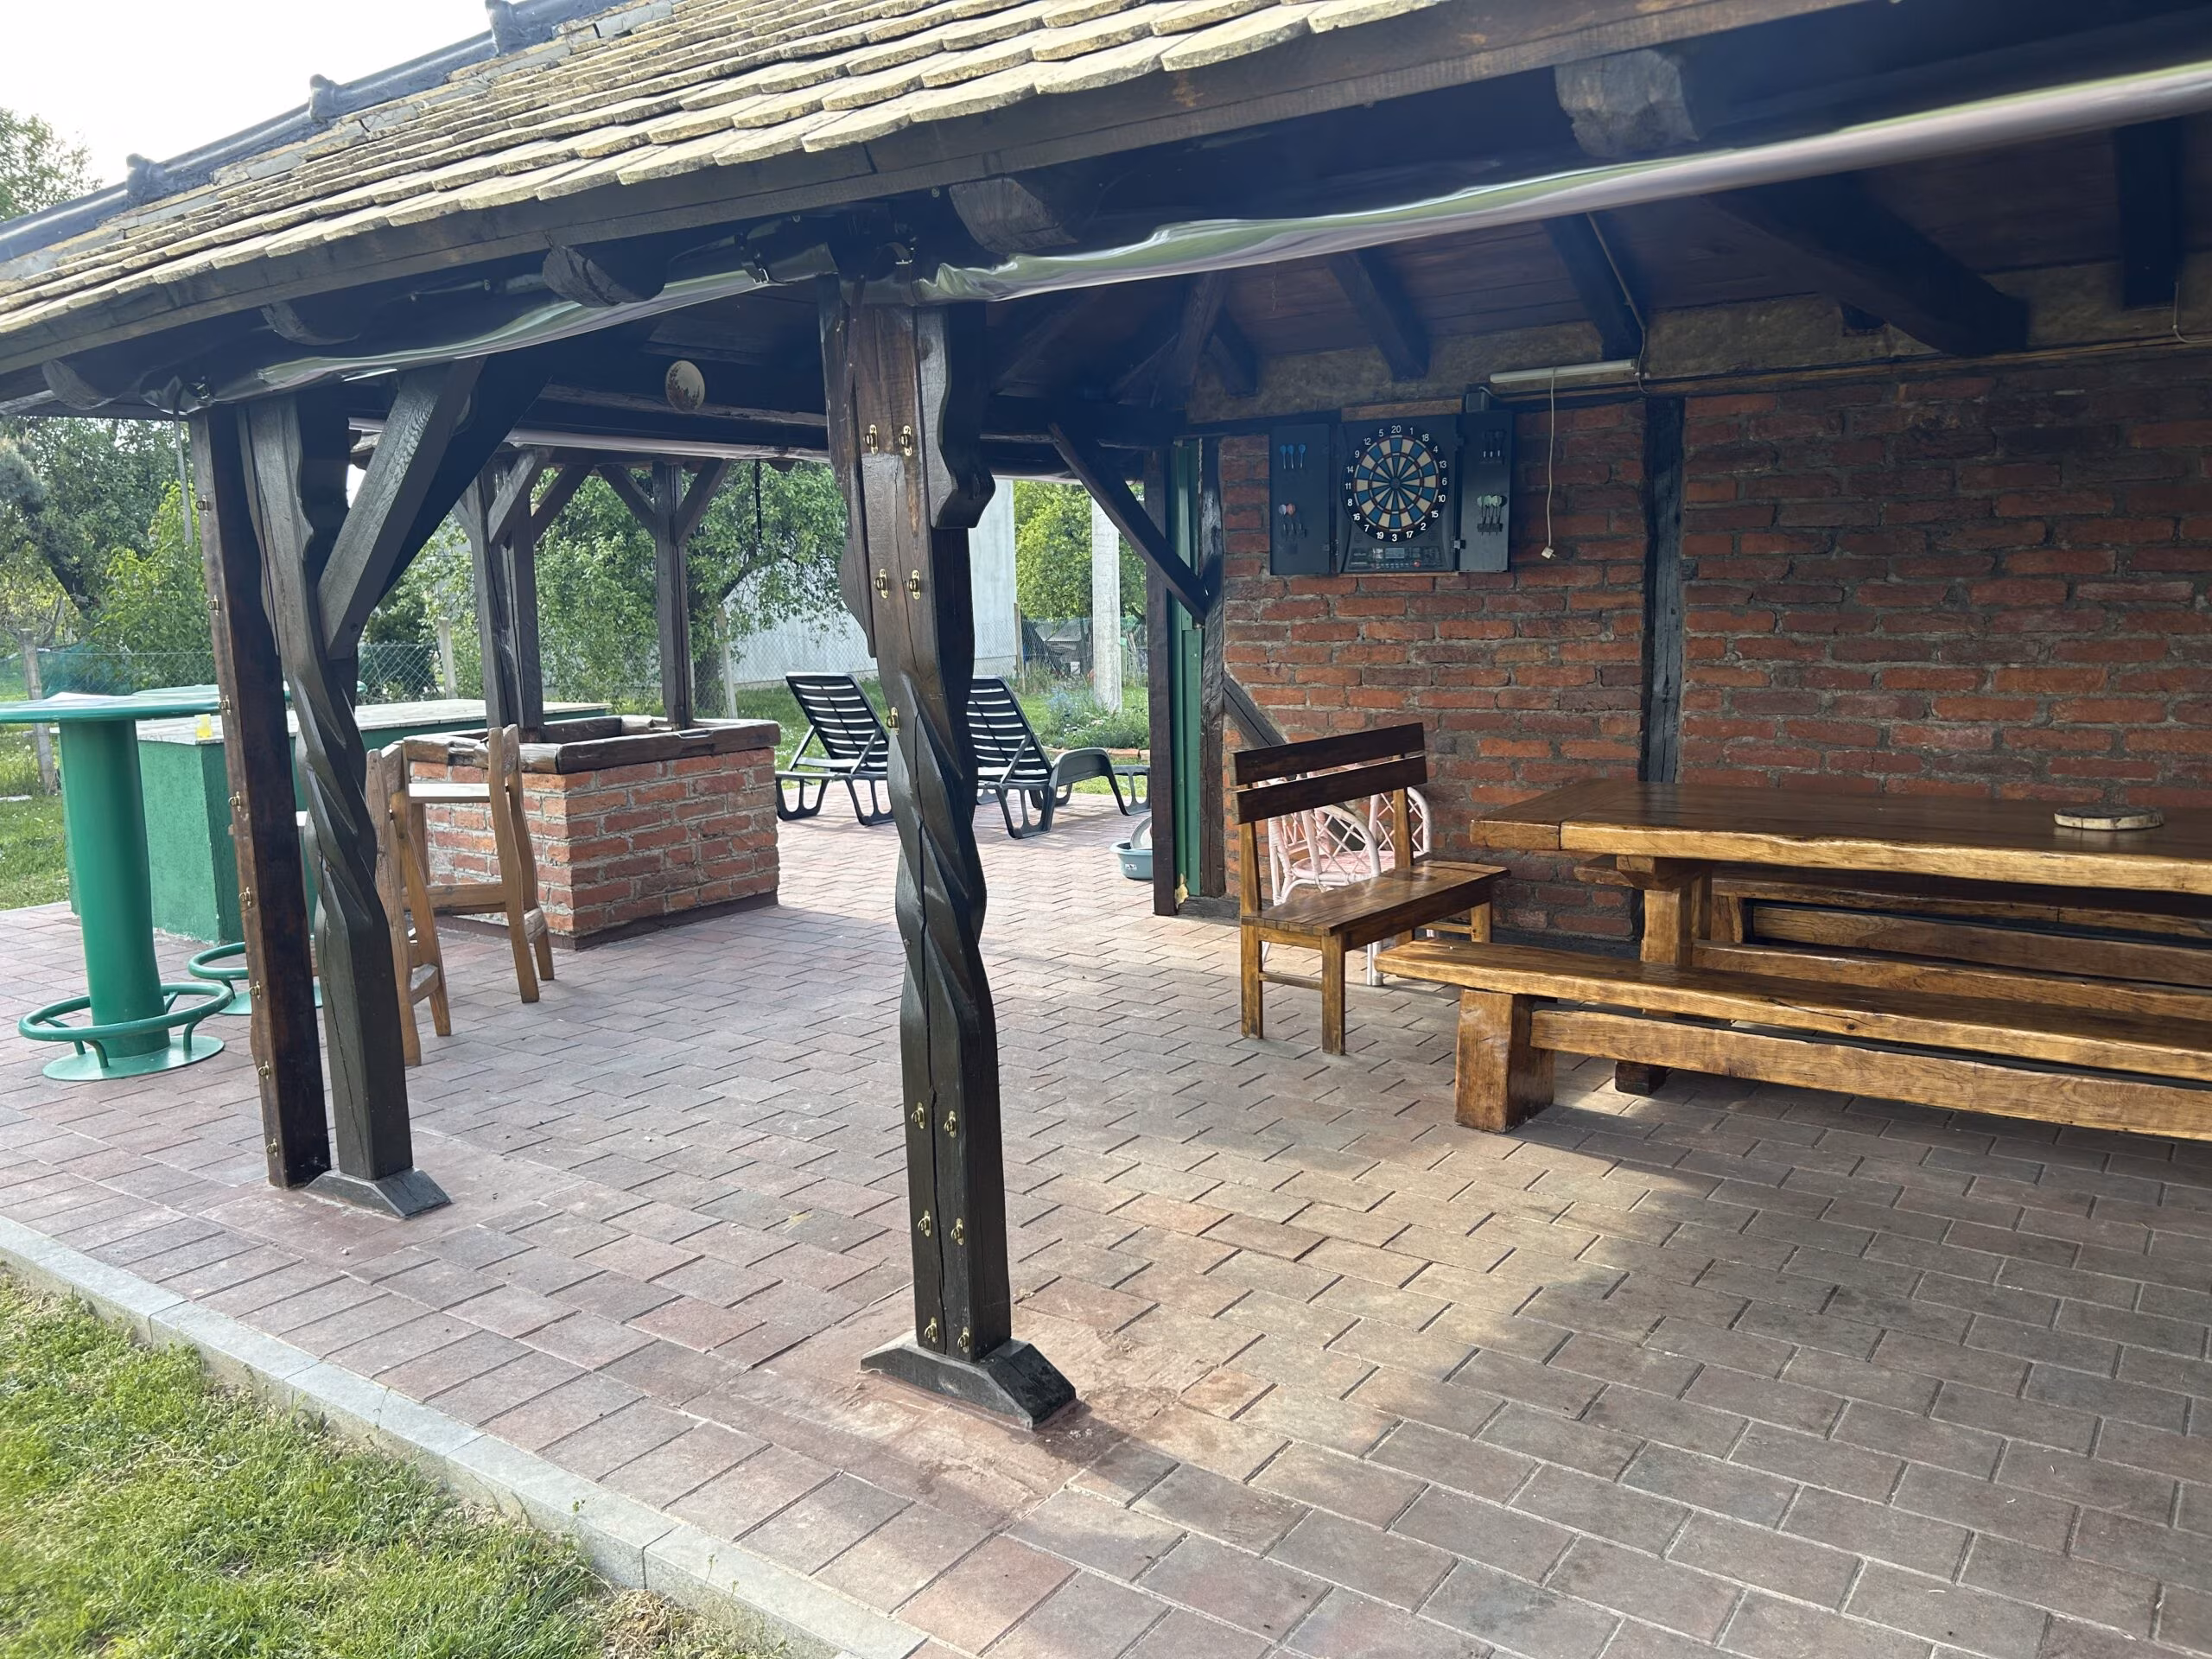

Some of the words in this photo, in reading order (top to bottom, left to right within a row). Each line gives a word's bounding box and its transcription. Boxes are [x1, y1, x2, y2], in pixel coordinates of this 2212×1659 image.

[1378, 429, 1384, 437] 5
[1391, 425, 1402, 434] 20
[1363, 437, 1371, 446] 12
[1421, 433, 1430, 442] 18
[1354, 449, 1360, 458] 9
[1433, 445, 1439, 454] 4
[1439, 460, 1447, 468] 13
[1441, 477, 1447, 486] 6
[1347, 498, 1353, 506] 8
[1438, 494, 1446, 503] 10
[1352, 512, 1361, 521] 16
[1431, 510, 1439, 518] 15
[1363, 524, 1370, 532] 7
[1420, 522, 1427, 531] 2
[1376, 531, 1384, 540] 19
[1391, 533, 1397, 542] 3
[1406, 531, 1414, 539] 17
